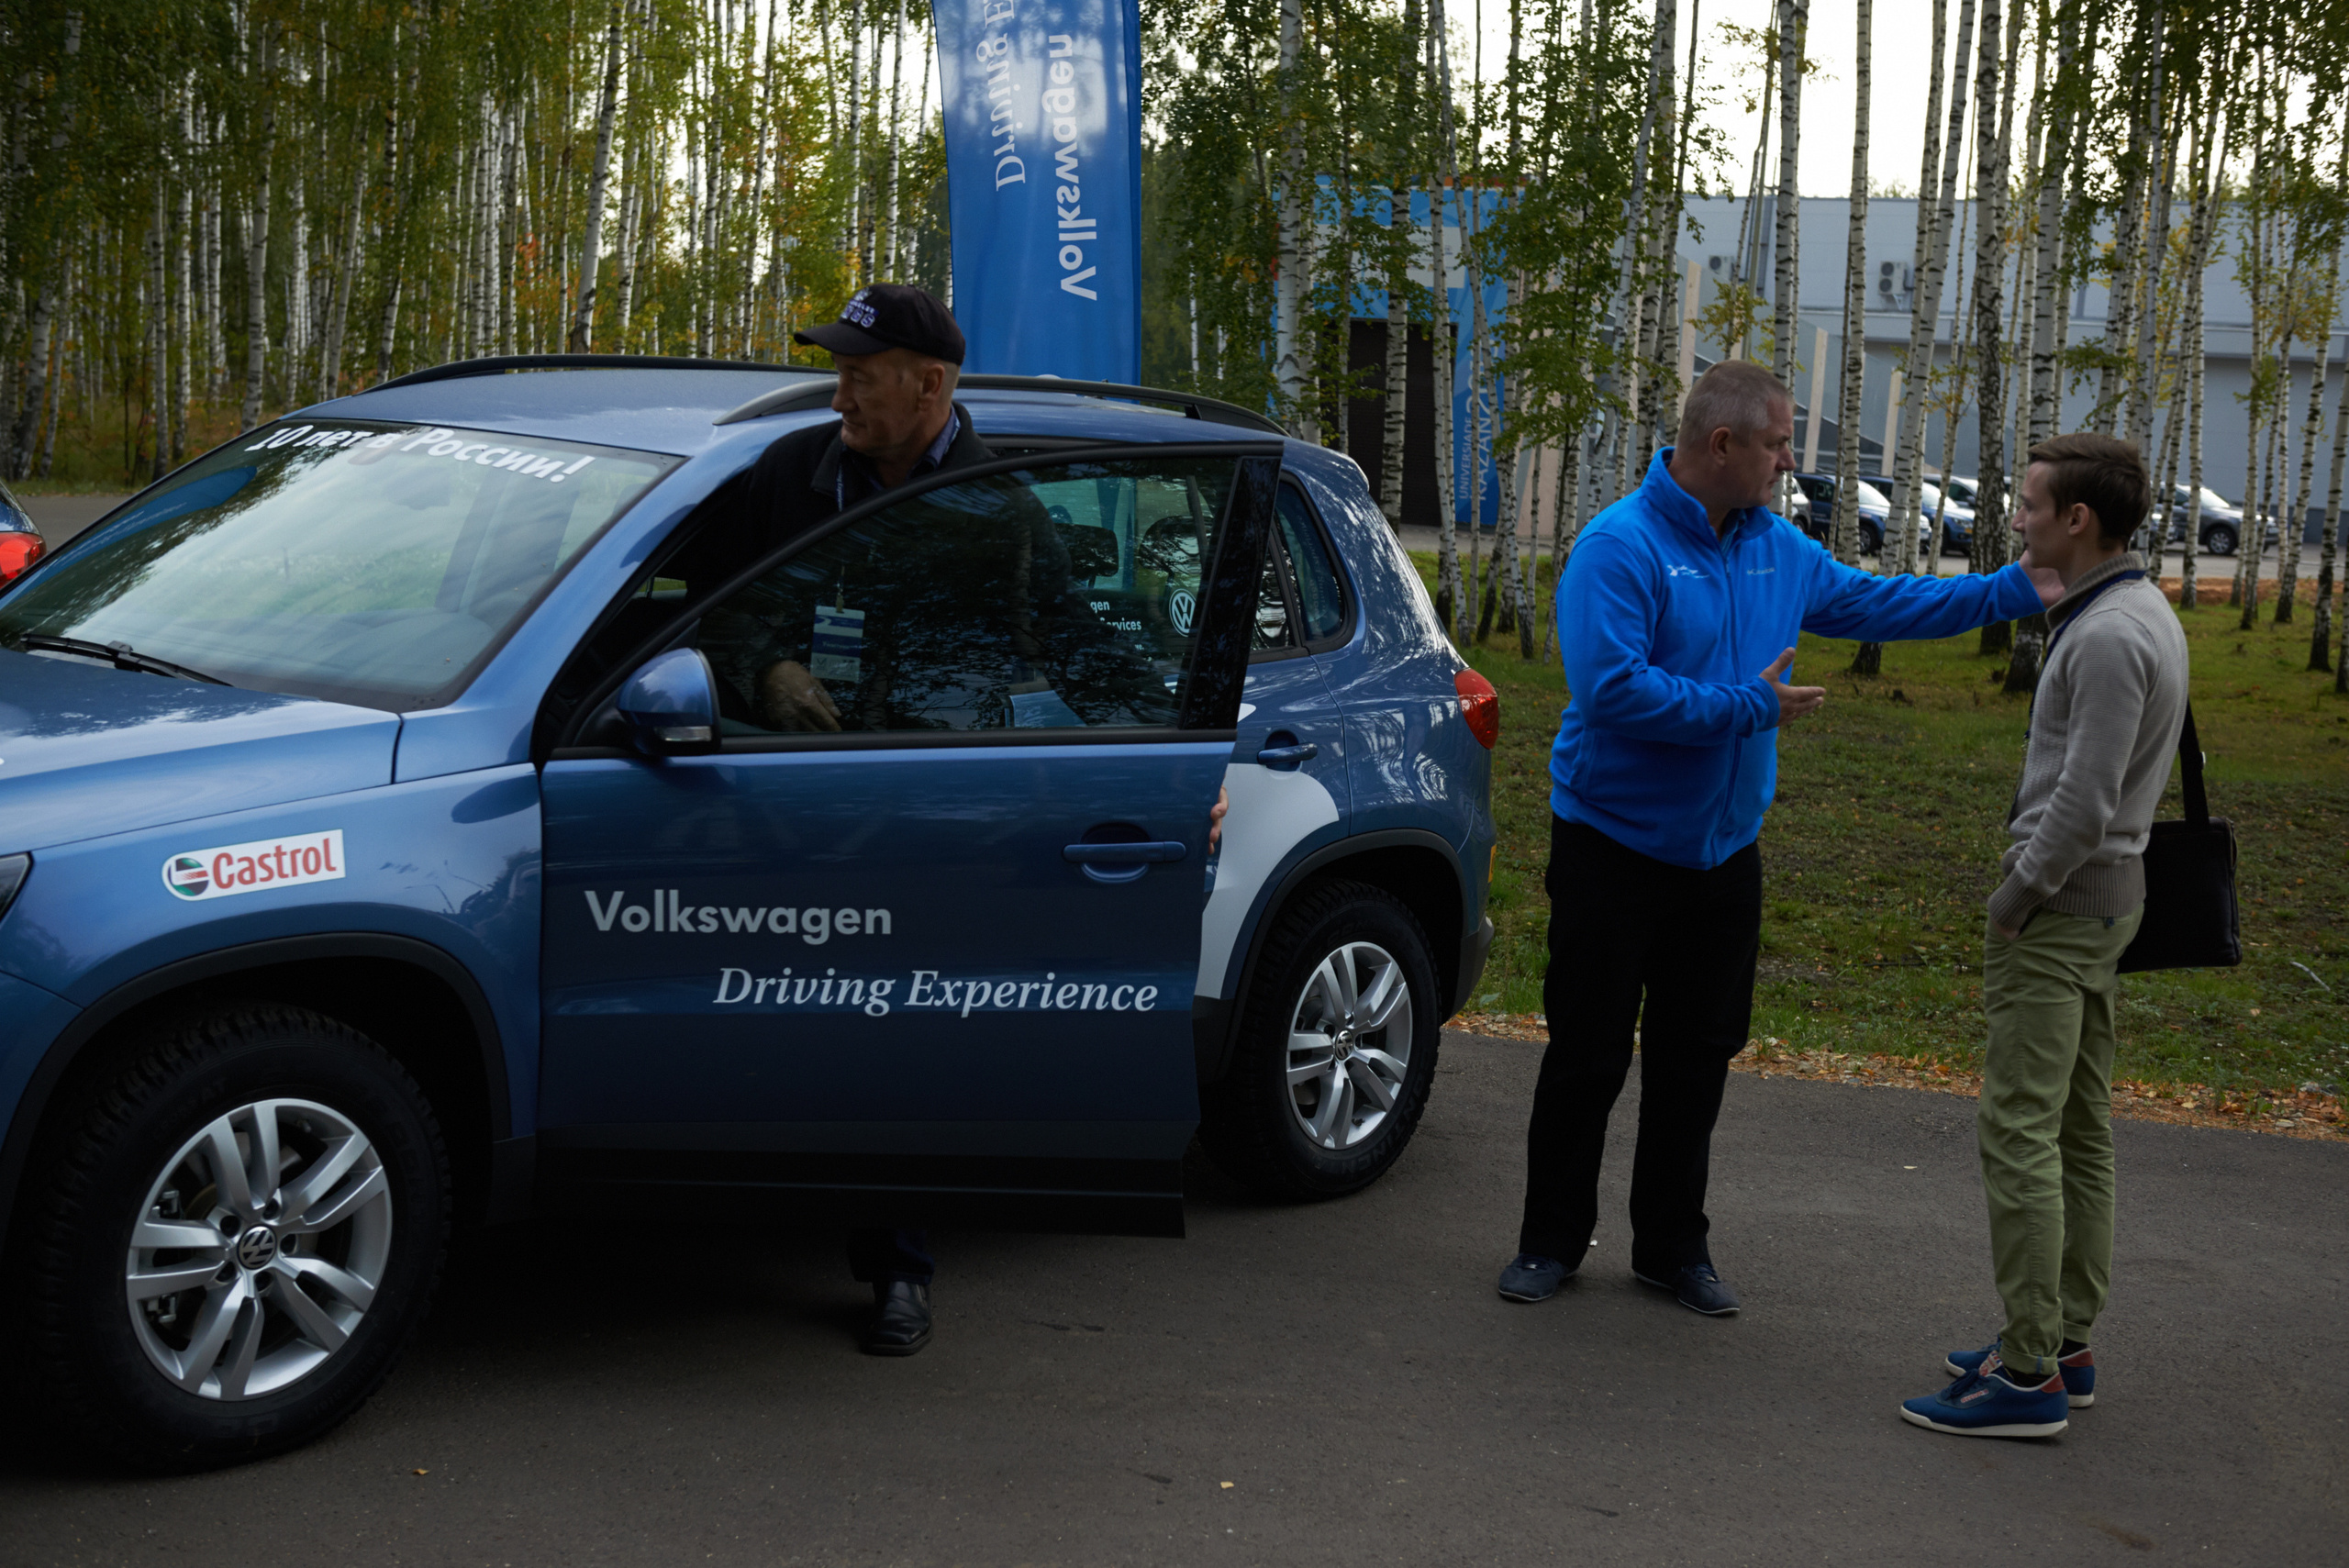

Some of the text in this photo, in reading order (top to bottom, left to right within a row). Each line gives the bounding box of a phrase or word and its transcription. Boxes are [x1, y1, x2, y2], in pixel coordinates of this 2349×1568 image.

[244, 425, 596, 483] 10 лет в России!
[213, 838, 337, 889] Castrol
[584, 889, 892, 945] Volkswagen
[712, 967, 1158, 1018] Driving Experience
